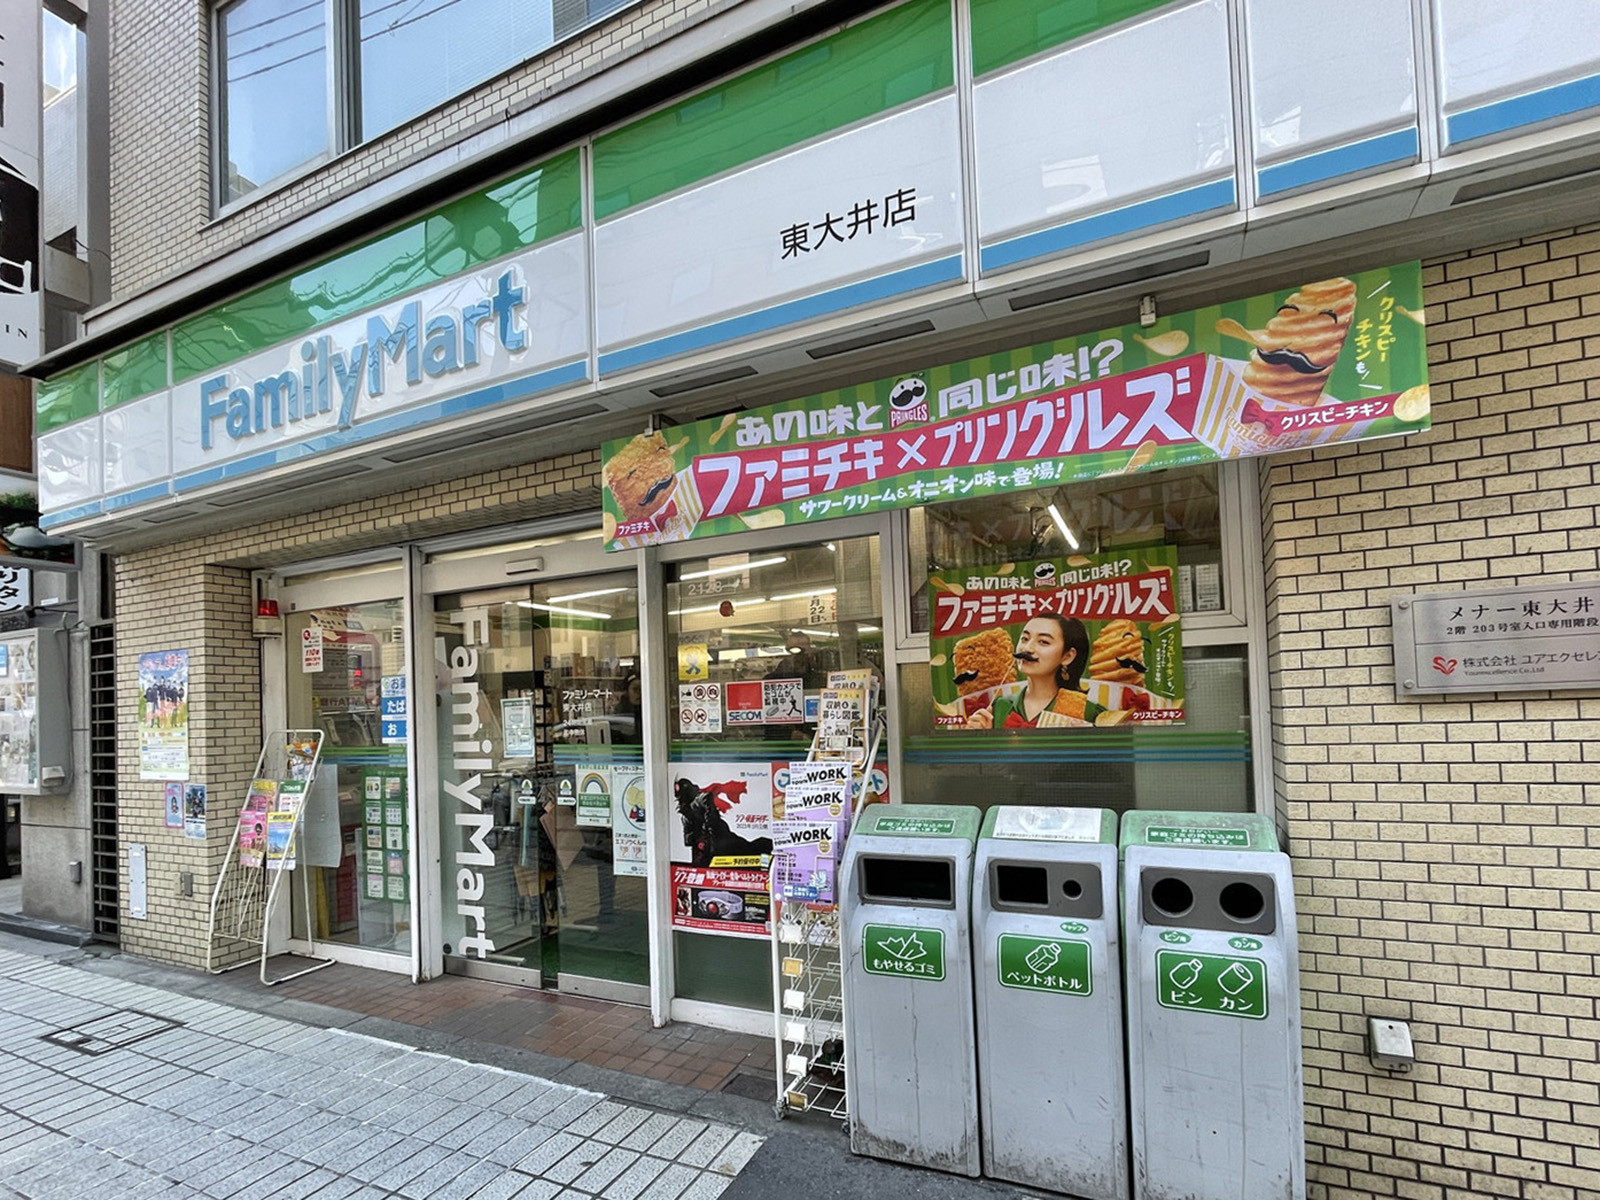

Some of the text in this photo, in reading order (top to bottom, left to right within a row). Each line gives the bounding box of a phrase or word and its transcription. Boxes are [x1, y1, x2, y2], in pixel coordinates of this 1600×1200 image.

[780, 188, 917, 260] 東大井店
[1377, 296, 1396, 362] クリスピー
[200, 270, 528, 450] FamilyMart
[736, 401, 883, 447] あの味と
[890, 405, 928, 427] PRINGLES
[1280, 401, 1388, 430] クリスピーチキン
[618, 521, 650, 536] ファミチキ
[966, 575, 1031, 591] あの味と
[1450, 597, 1594, 621] メナー東大井
[1463, 656, 1517, 667] 株式会社
[562, 688, 613, 700] ファミリーマート
[728, 711, 762, 721] SECOM
[1132, 710, 1182, 720] クリスピーチキン
[443, 606, 496, 960] FamilyMart
[807, 767, 847, 782] WORK
[803, 791, 843, 806] WORK
[790, 827, 832, 843] WORK
[873, 958, 935, 975] もやせるゴミ
[1007, 972, 1082, 989] ペットボトル
[1171, 991, 1253, 1010] ビン カン
